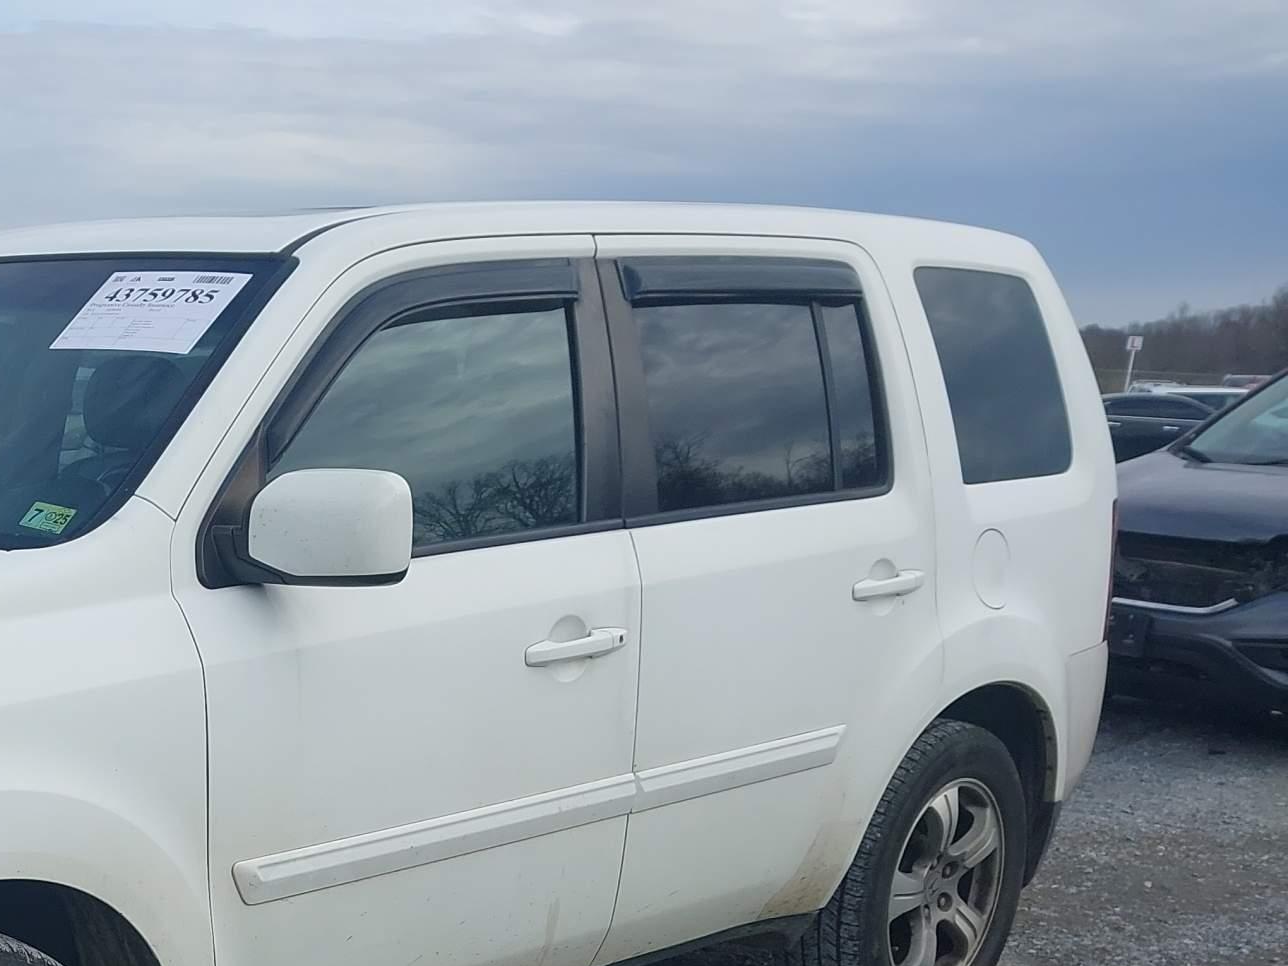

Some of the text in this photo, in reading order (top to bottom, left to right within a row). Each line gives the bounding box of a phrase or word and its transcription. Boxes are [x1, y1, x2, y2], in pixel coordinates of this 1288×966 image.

[104, 287, 220, 304] 43759785
[28, 508, 44, 523] 7
[53, 513, 72, 526] 25
